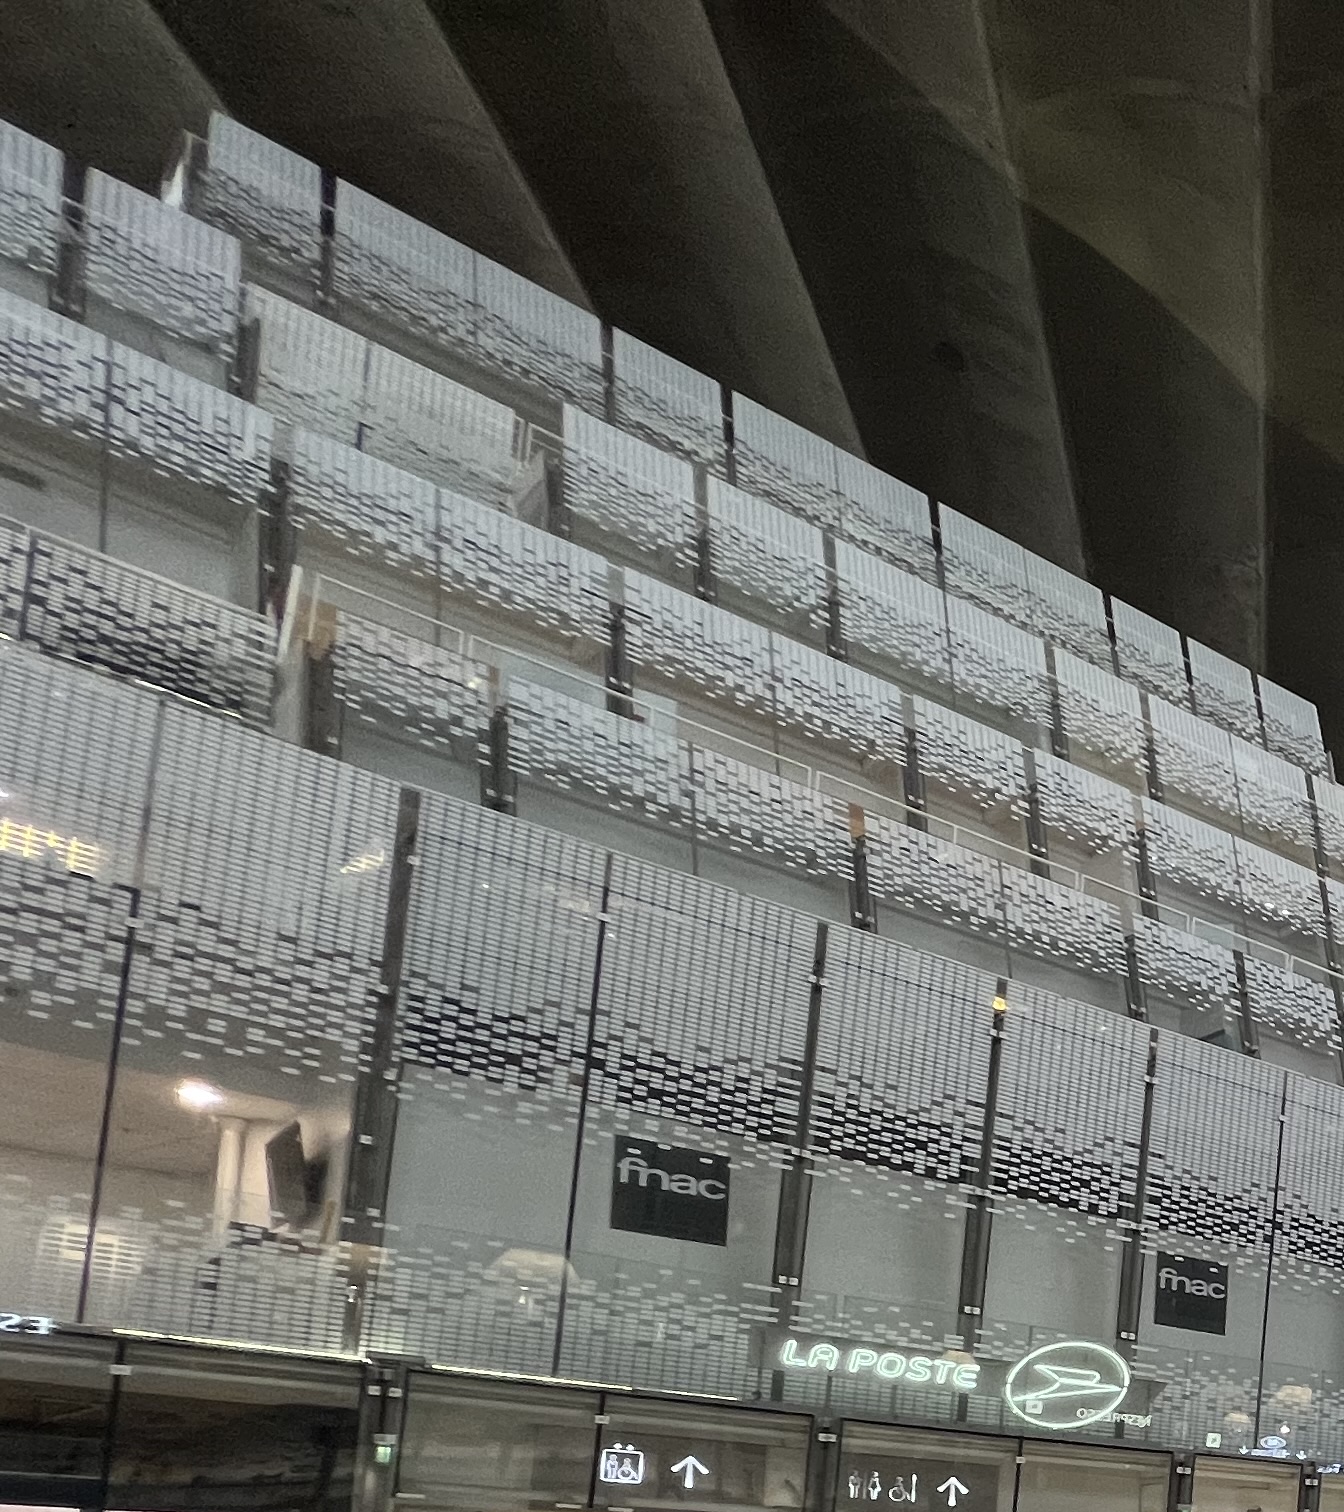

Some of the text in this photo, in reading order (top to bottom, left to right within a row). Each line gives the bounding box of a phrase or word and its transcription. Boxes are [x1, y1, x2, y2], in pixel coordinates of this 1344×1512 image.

[617, 1156, 726, 1200] fnac
[1159, 1268, 1226, 1299] fnac
[781, 1339, 980, 1389] LA POSTE
